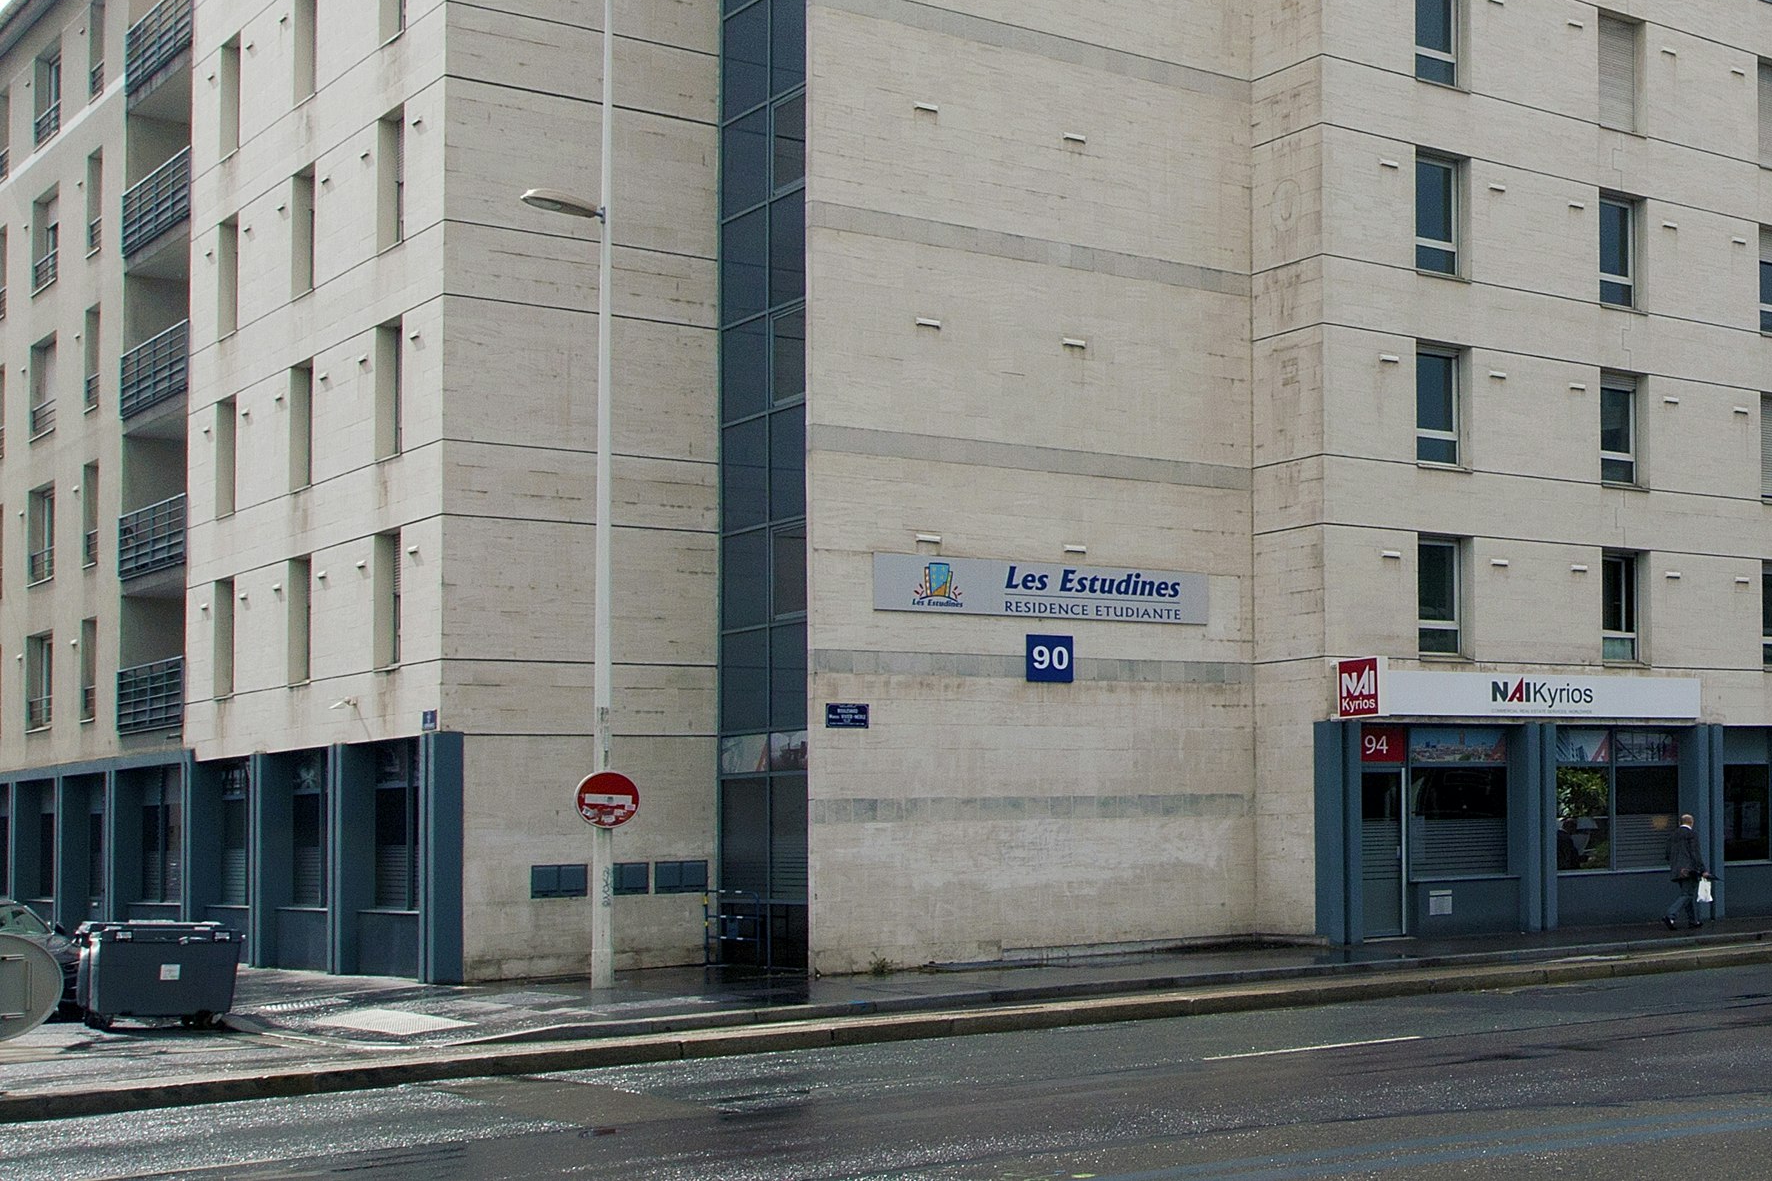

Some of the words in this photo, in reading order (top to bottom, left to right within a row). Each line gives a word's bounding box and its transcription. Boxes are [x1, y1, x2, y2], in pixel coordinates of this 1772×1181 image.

[1005, 566, 1049, 591] Les
[1059, 569, 1180, 598] Estudines
[911, 598, 925, 607] Les
[927, 599, 964, 608] Estudines
[1004, 601, 1090, 616] RESIDENCE
[1095, 605, 1182, 620] ETUDIANTE
[1032, 645, 1069, 670] 90
[1341, 664, 1376, 698] NAI
[1341, 697, 1376, 713] Kyrios
[1364, 735, 1388, 754] 94
